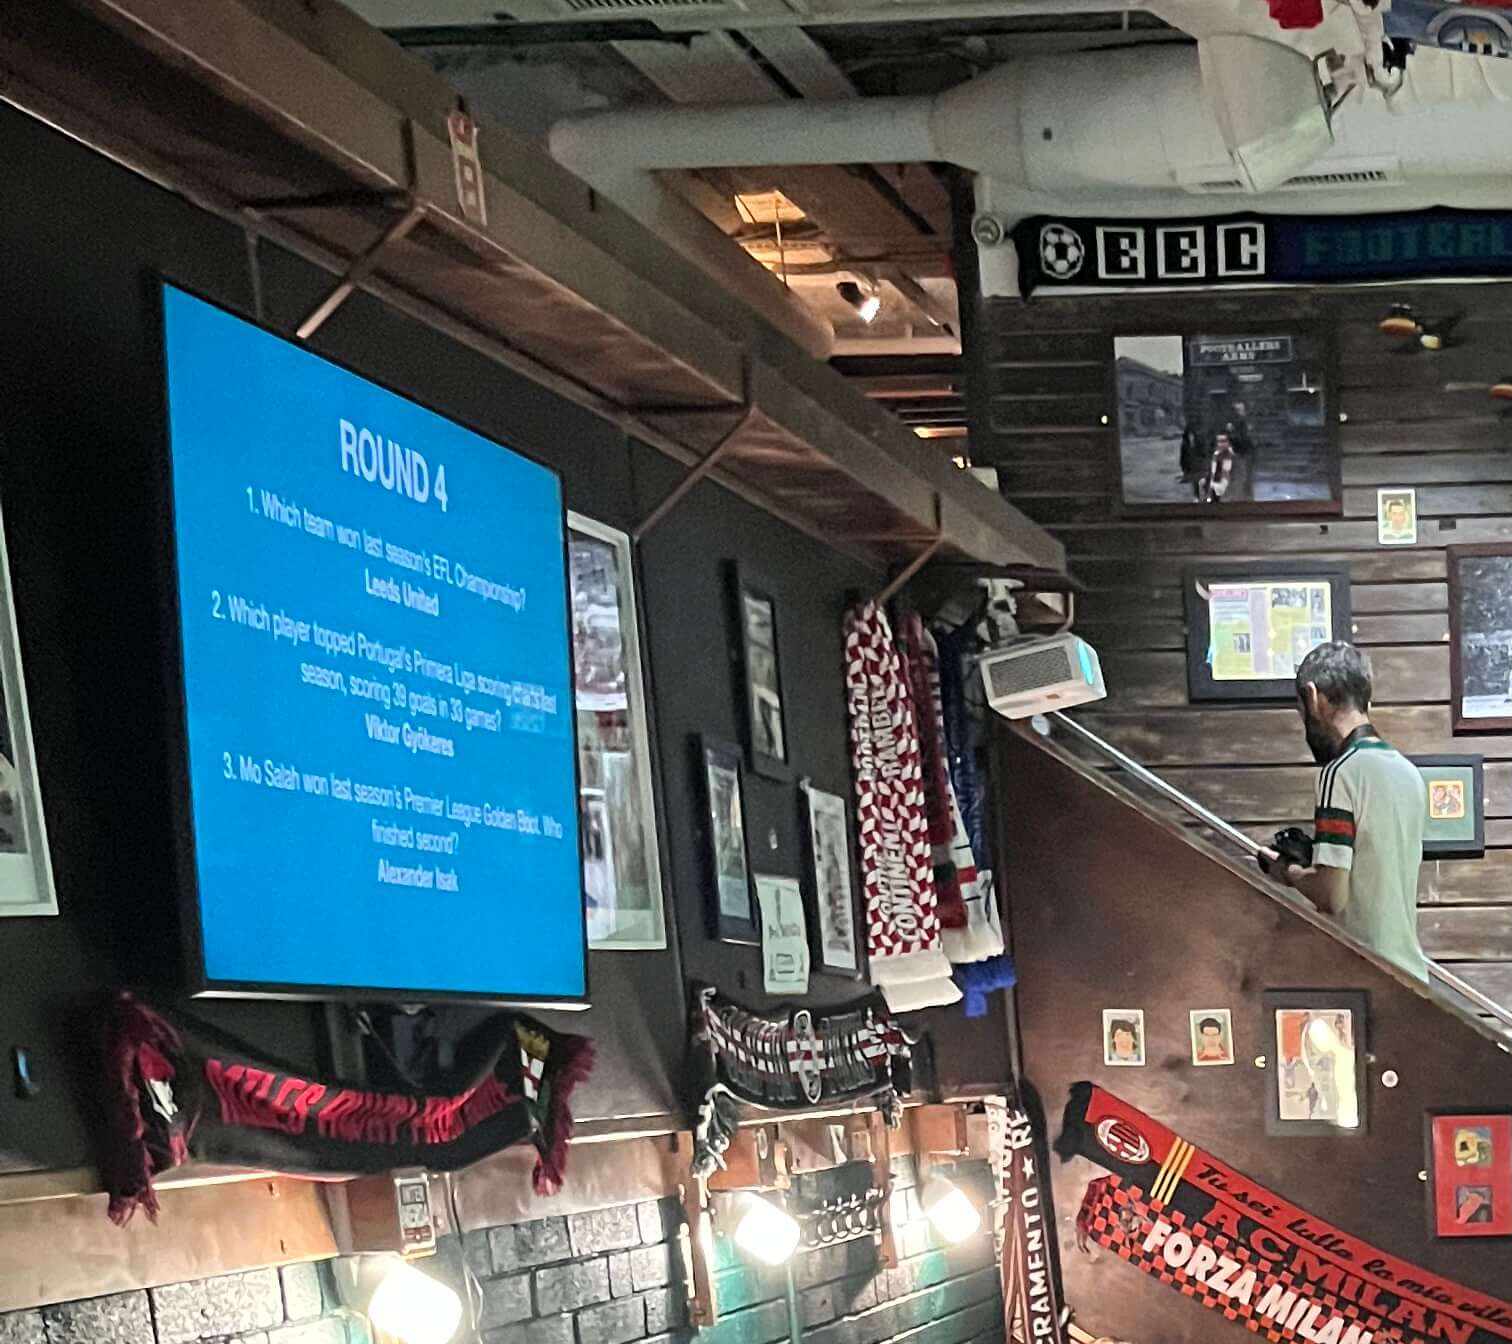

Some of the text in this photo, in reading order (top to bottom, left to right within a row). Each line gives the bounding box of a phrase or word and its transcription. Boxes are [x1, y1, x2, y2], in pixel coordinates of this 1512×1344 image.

[339, 418, 448, 512] ROUND 4
[247, 485, 525, 613] 1. Which team won last season's EFL Championship?
[365, 567, 439, 616] Leeds United
[211, 590, 226, 619] 2.
[228, 594, 270, 631] Which
[273, 608, 311, 646] player
[313, 620, 355, 657] topped
[358, 631, 413, 674] Portugal's
[454, 662, 475, 694] Liga
[477, 674, 512, 706] scoring
[301, 662, 501, 732] season, scoring 39 goals in 33 games?
[365, 713, 400, 744] Viktor
[223, 751, 237, 780] 3.
[240, 755, 261, 784] Mo
[264, 759, 300, 791] Salah
[303, 774, 328, 797] won
[330, 772, 352, 801] last
[354, 782, 402, 810] season's
[404, 787, 443, 816] Premier
[446, 794, 481, 829] League
[483, 803, 517, 830] Golden
[543, 815, 563, 839] Who
[372, 819, 459, 855] finished second?
[378, 858, 459, 892] Alexander Isak
[1197, 1162, 1229, 1193] Tu
[1231, 1190, 1281, 1219] sei
[1142, 1219, 1258, 1306] FORZA
